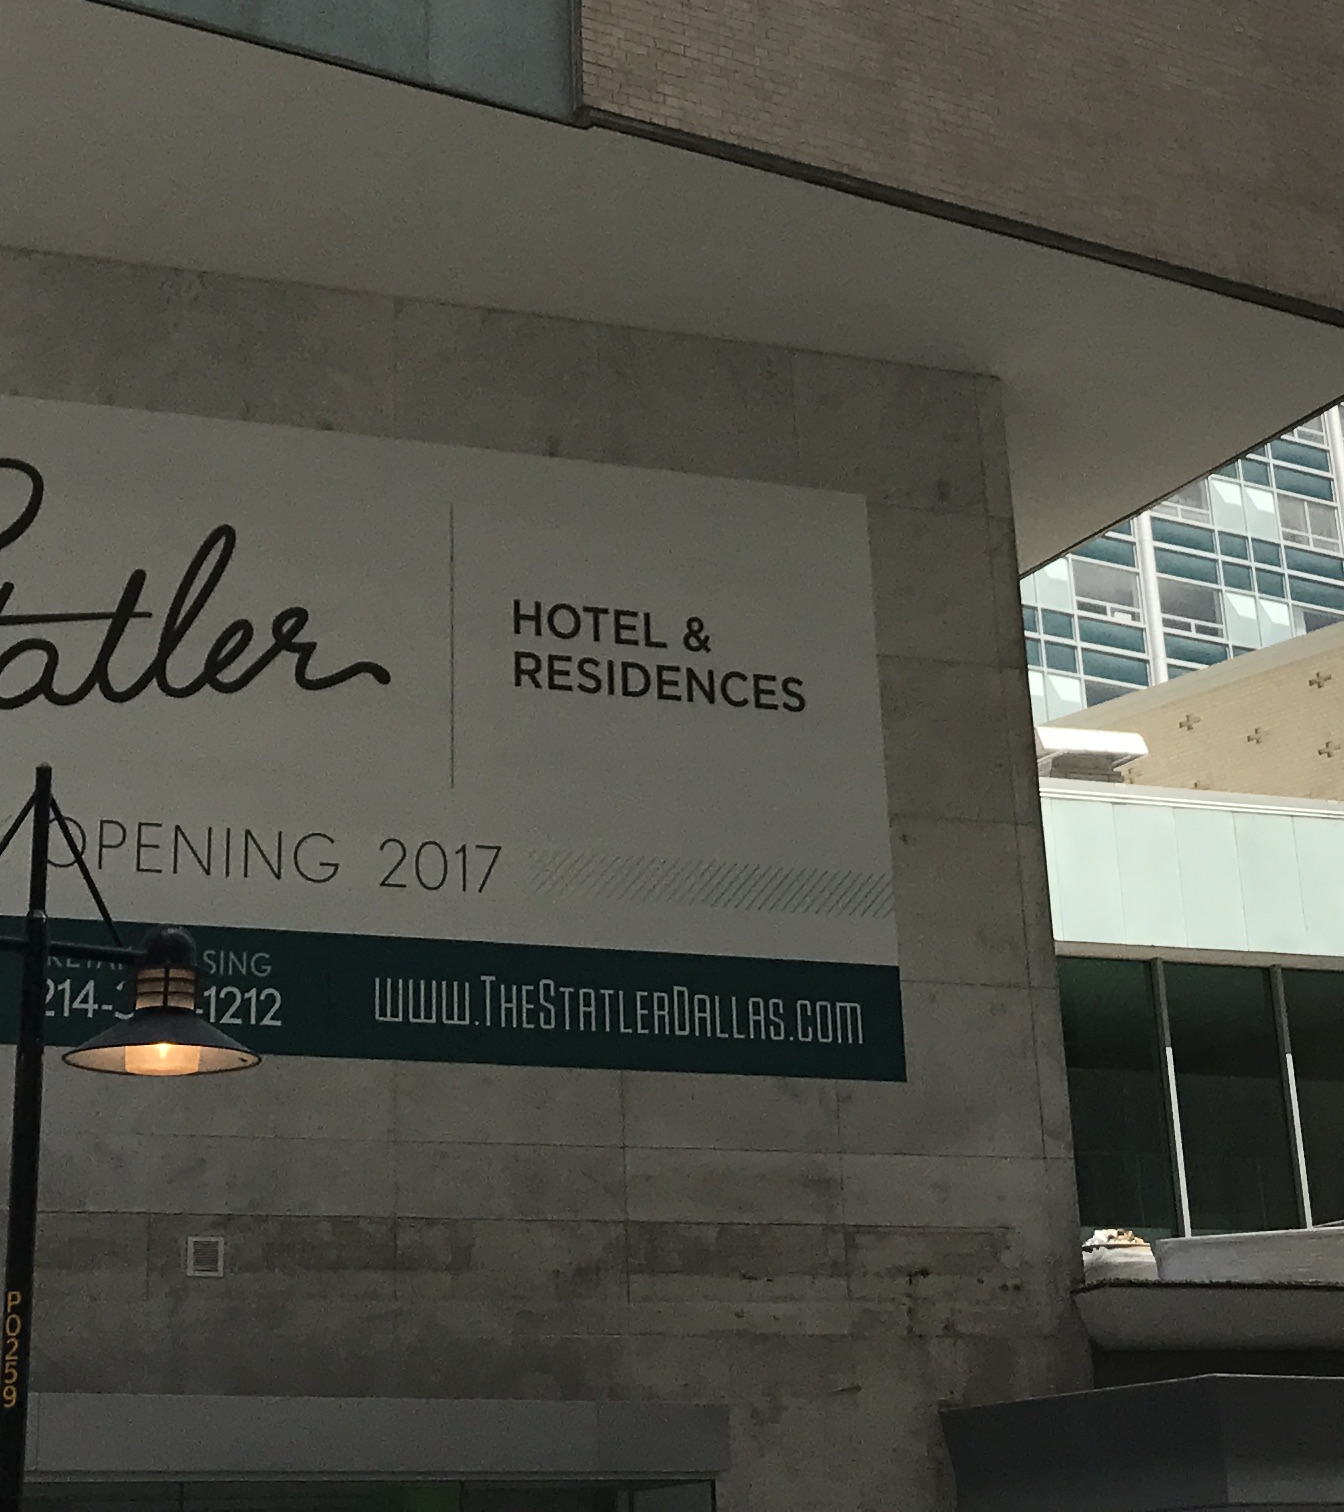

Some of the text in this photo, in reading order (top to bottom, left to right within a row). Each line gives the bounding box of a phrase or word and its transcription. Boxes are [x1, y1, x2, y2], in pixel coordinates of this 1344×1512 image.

[513, 599, 713, 652] HOTEL &
[514, 651, 807, 714] RESIDENCES
[44, 815, 503, 894] OPENING 2017
